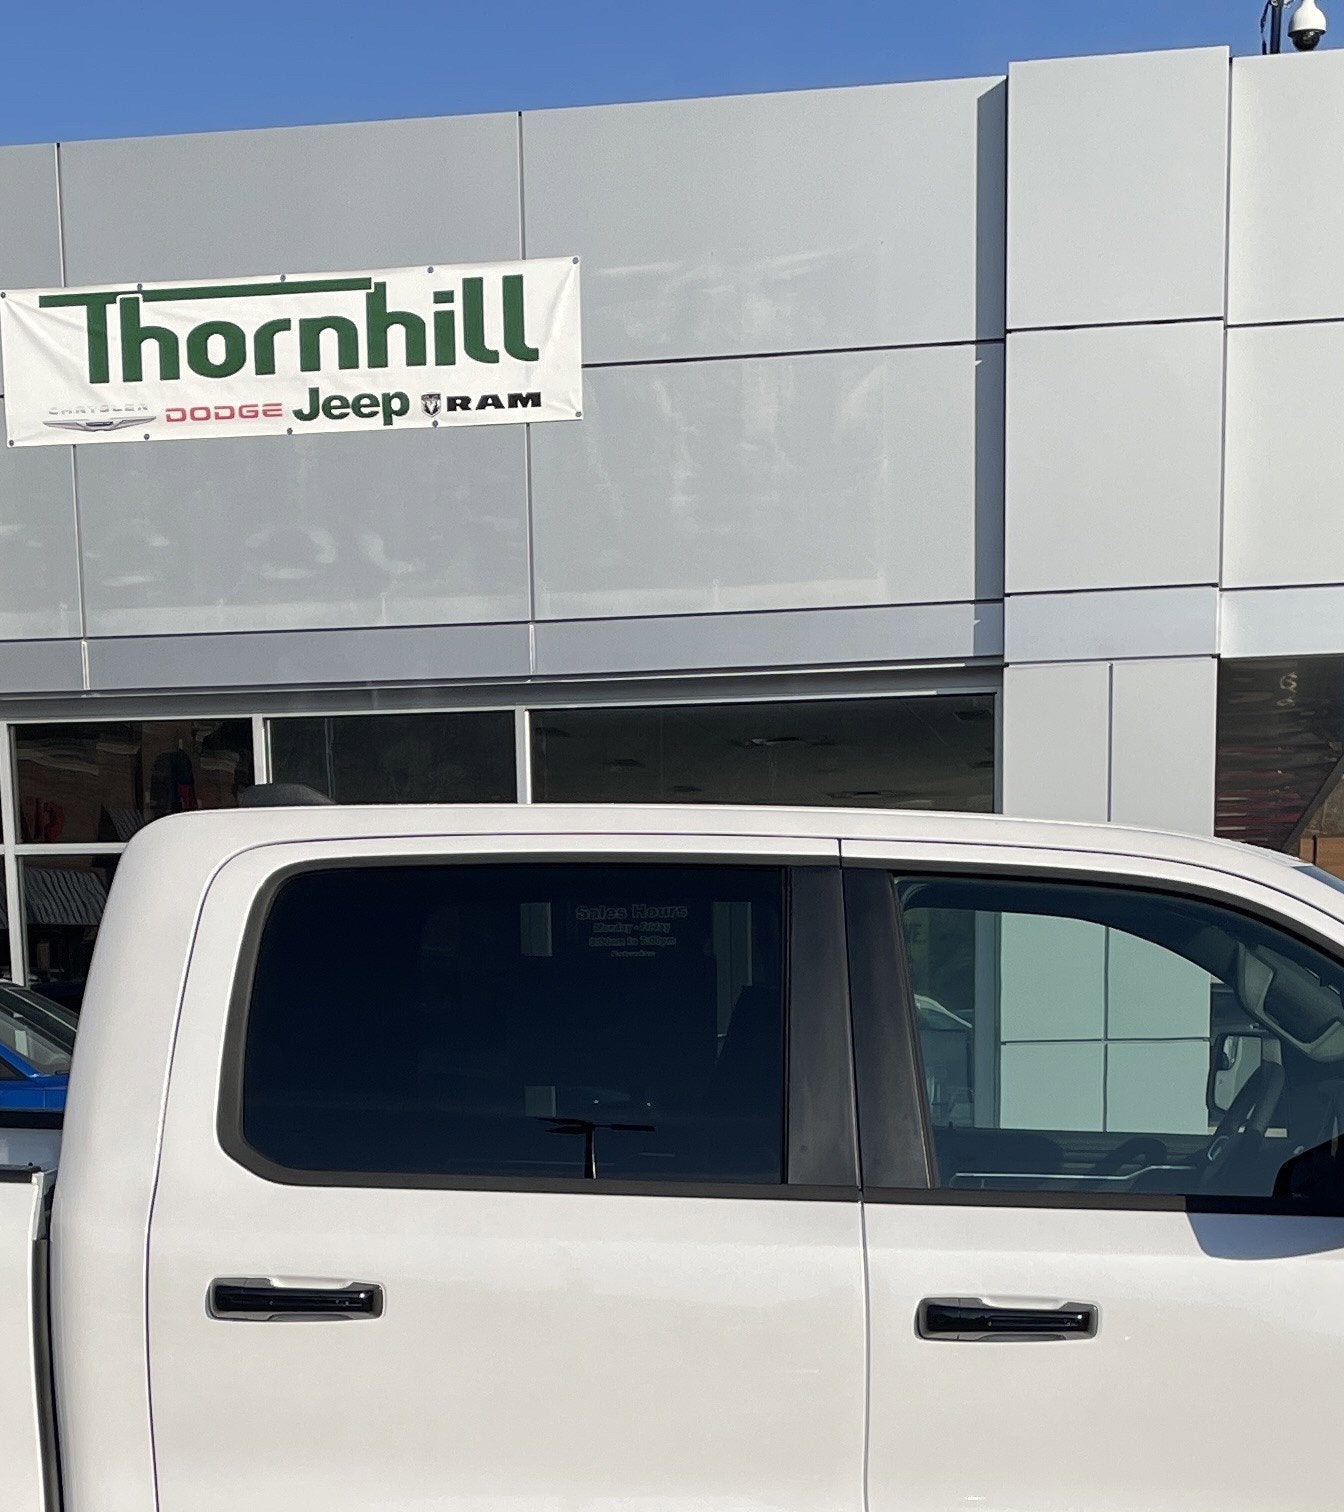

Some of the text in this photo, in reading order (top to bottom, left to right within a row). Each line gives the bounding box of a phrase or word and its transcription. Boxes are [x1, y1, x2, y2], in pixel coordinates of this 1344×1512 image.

[39, 274, 540, 384] Thornhill
[165, 402, 283, 422] DODGE
[292, 387, 410, 426] Jeep
[446, 391, 542, 412] RAM
[575, 903, 688, 920] Sales Hours
